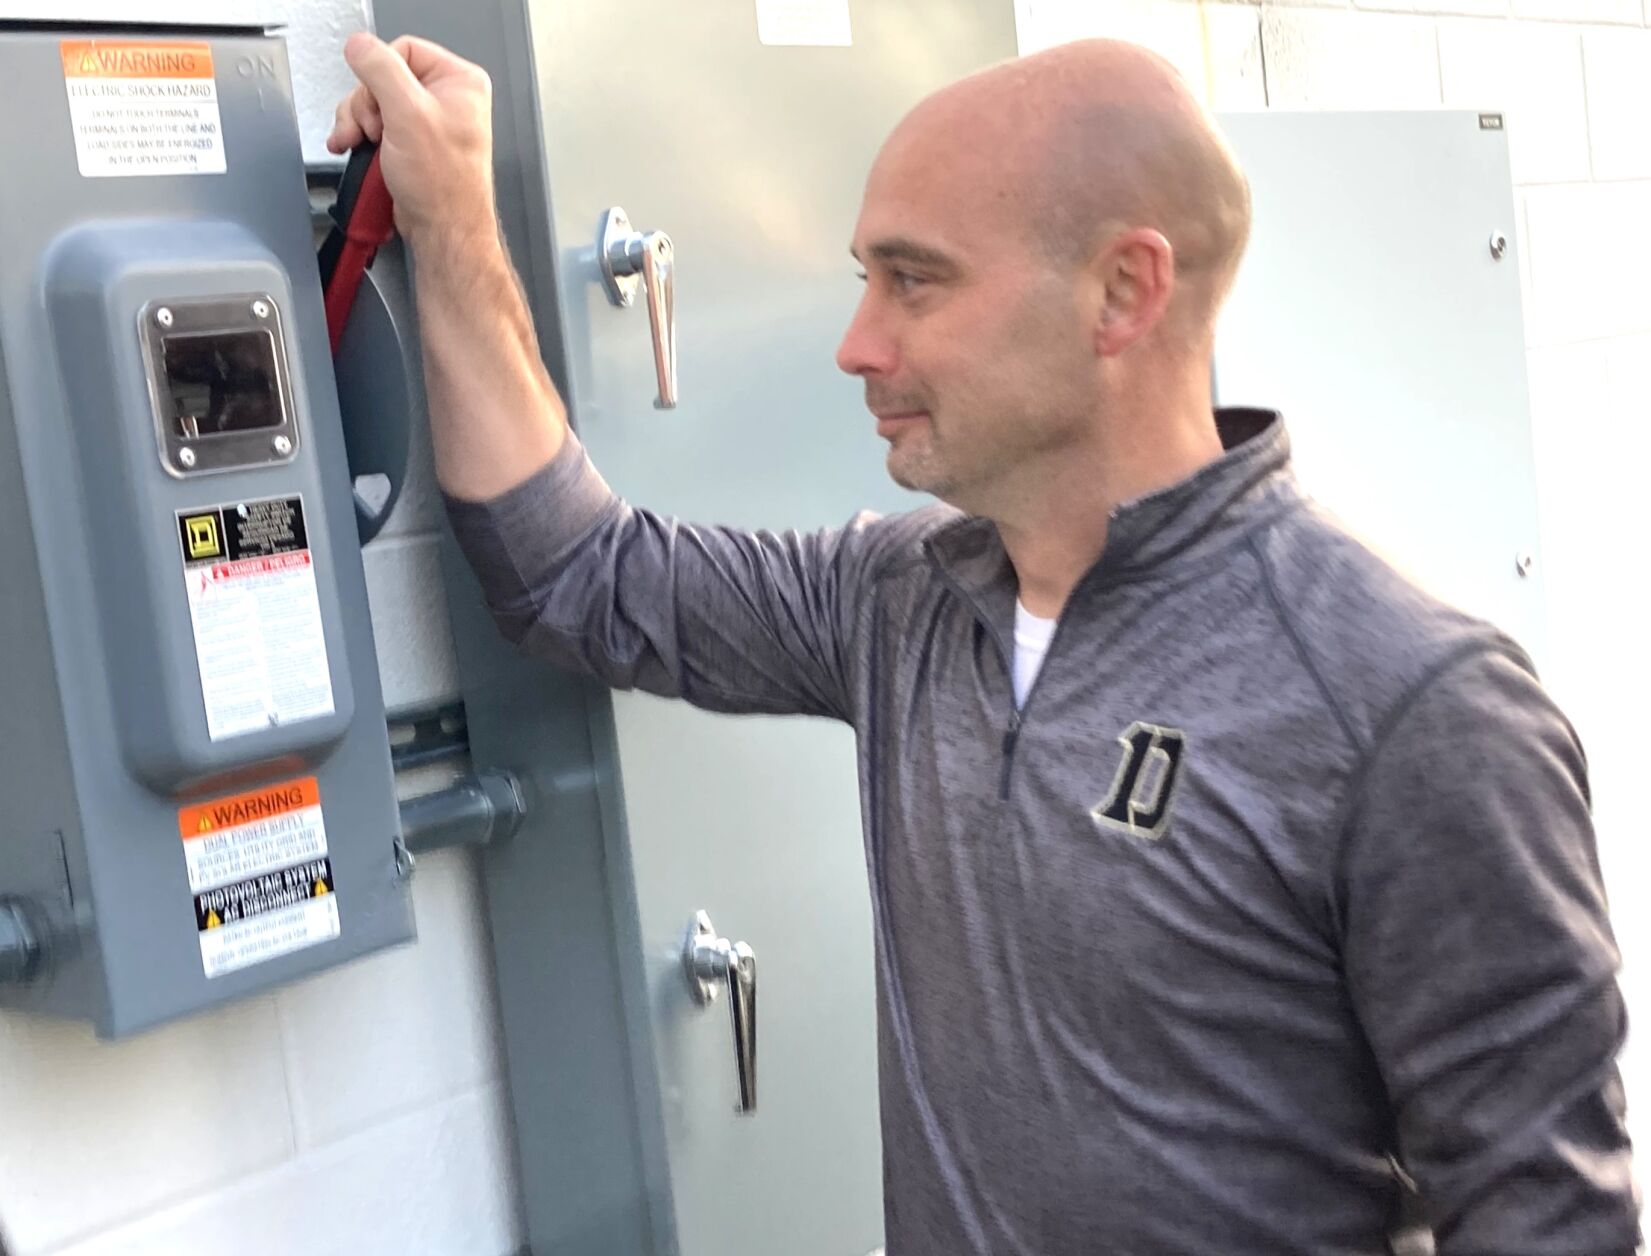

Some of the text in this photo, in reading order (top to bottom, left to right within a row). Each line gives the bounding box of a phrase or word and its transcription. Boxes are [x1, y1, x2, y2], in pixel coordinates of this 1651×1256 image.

[98, 51, 196, 73] WARNING
[236, 56, 277, 80] ON
[71, 83, 211, 98] ELECTRIC SHOCK HAZARD
[200, 123, 216, 134] AND
[137, 140, 153, 150] MAY
[214, 787, 303, 825] WARNING
[200, 860, 329, 915] PHOTOVOLTAIC SYSTEM
[243, 882, 312, 919] DISCONNECT
